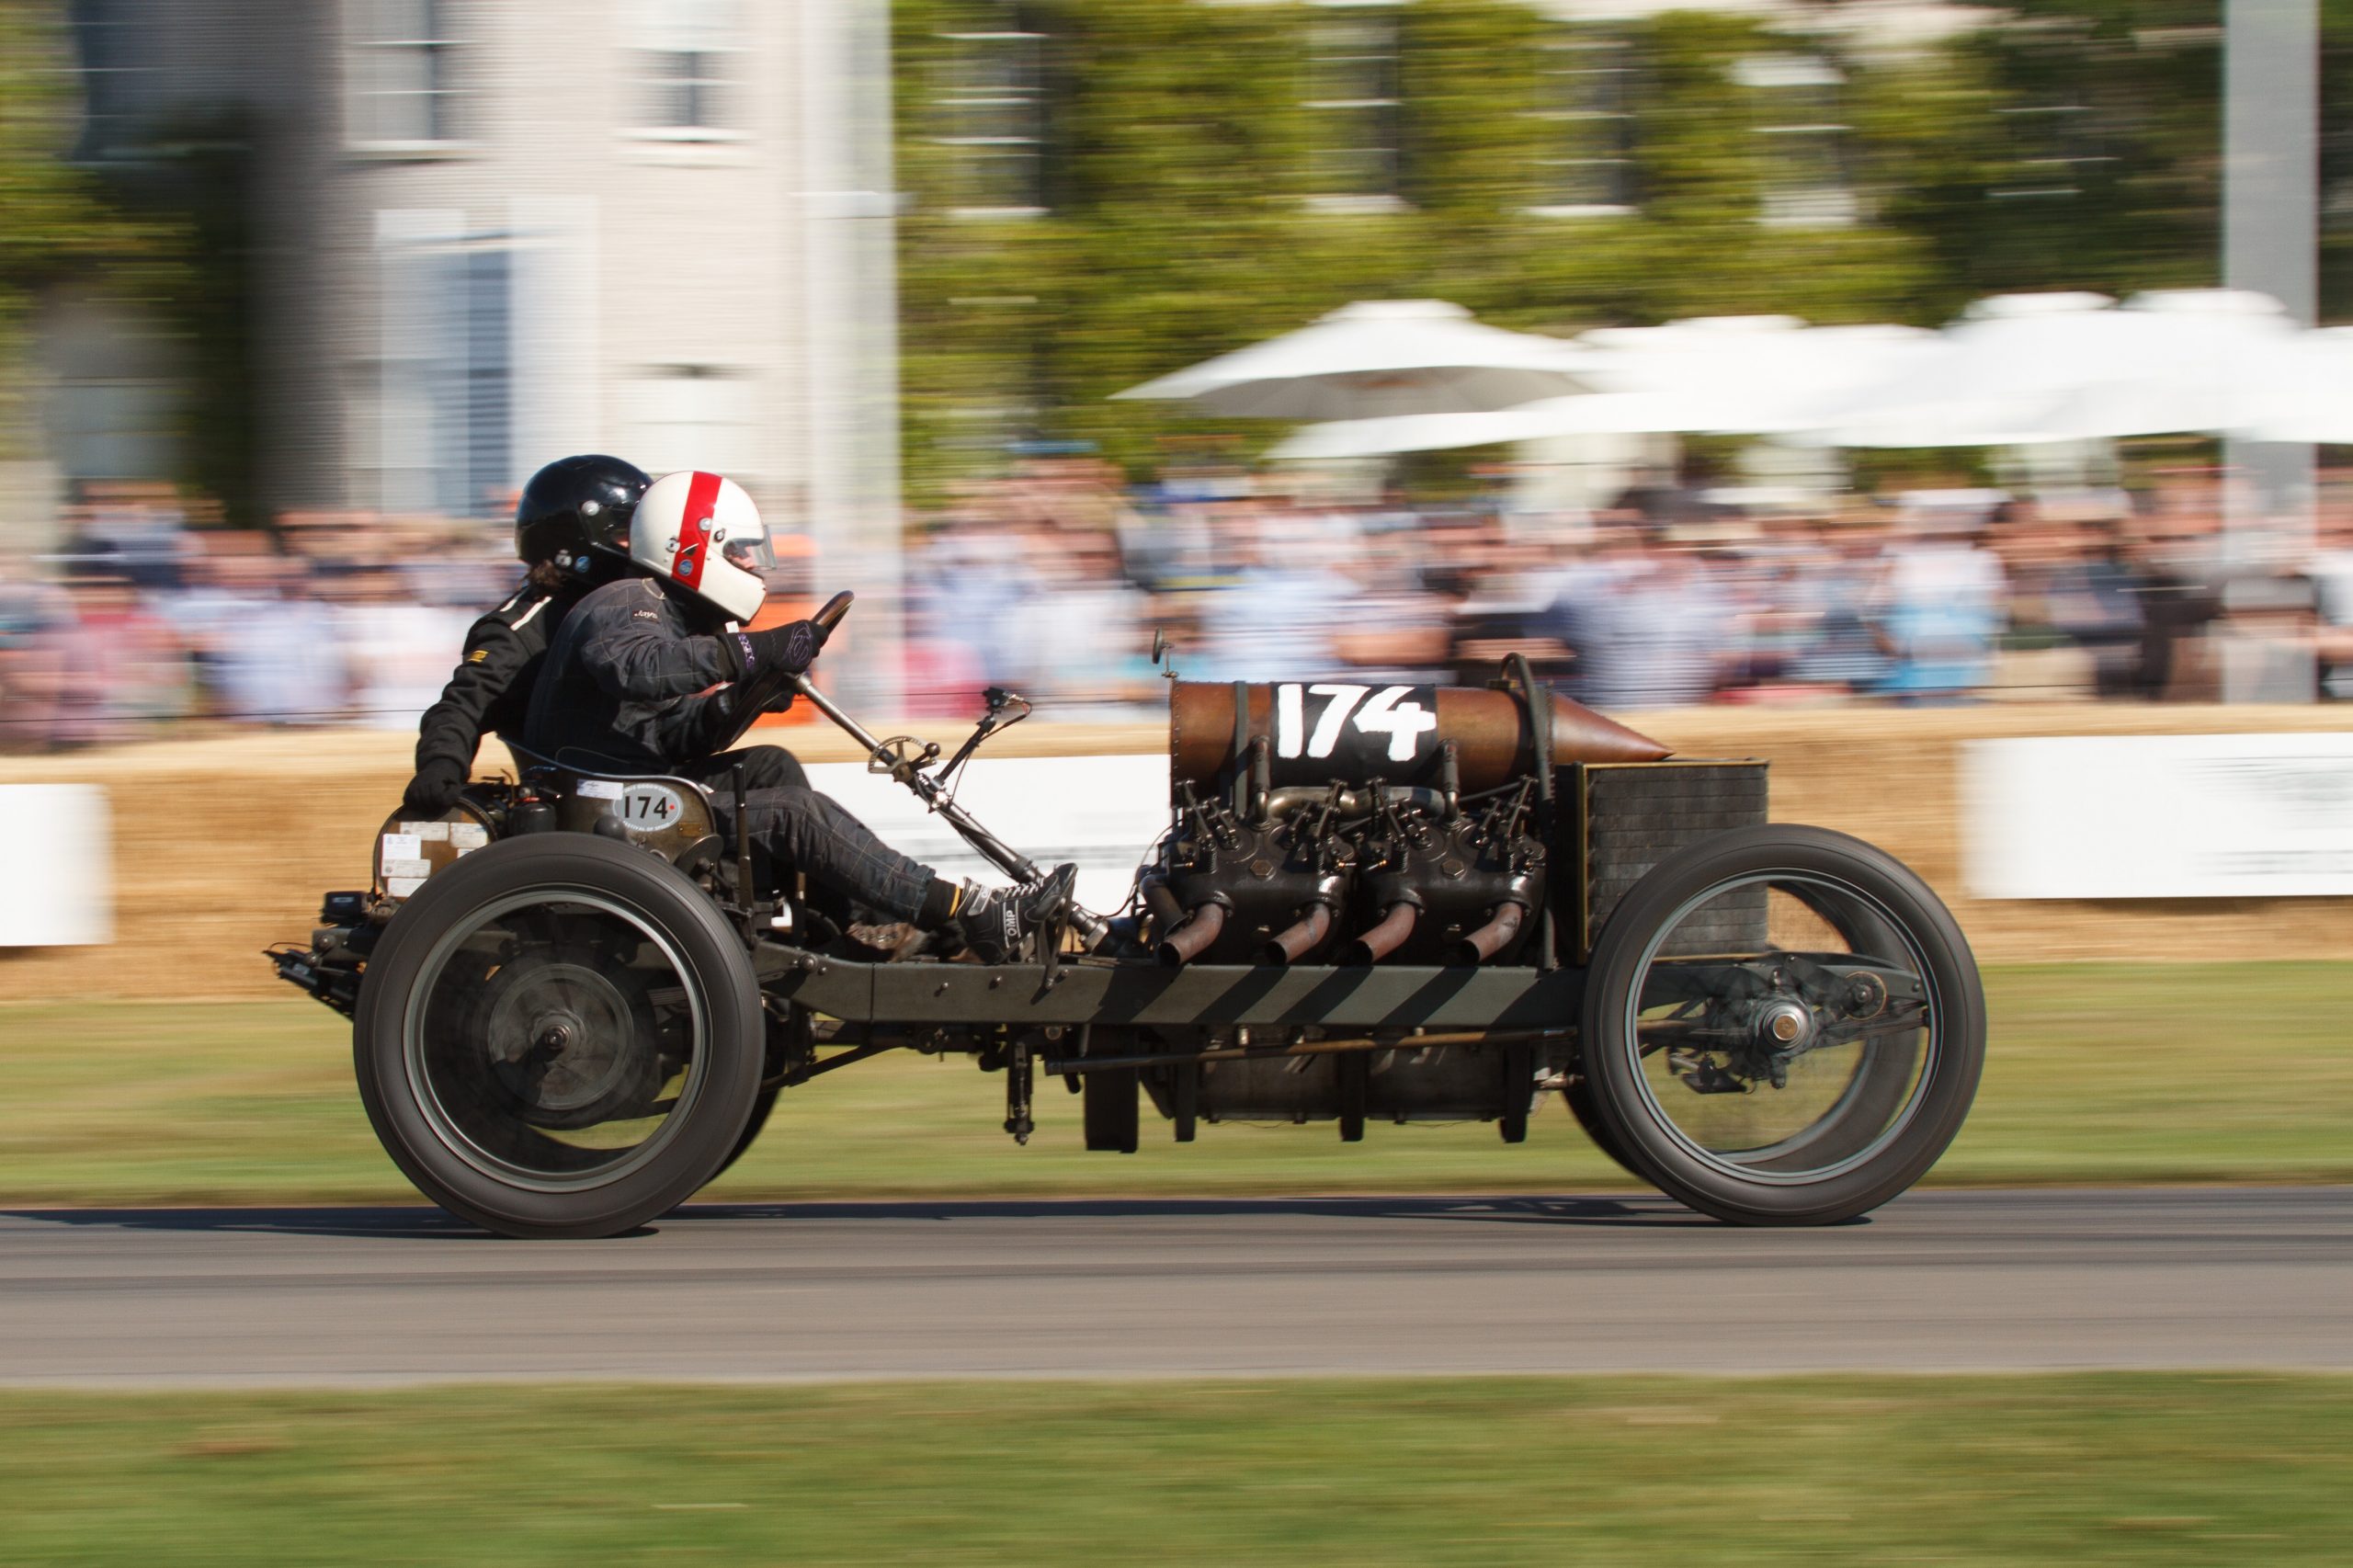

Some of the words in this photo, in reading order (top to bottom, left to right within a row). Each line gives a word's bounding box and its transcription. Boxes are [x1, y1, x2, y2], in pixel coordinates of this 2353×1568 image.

[1278, 683, 1438, 762] 174
[624, 795, 668, 820] 174
[1006, 909, 1017, 937] OMP
